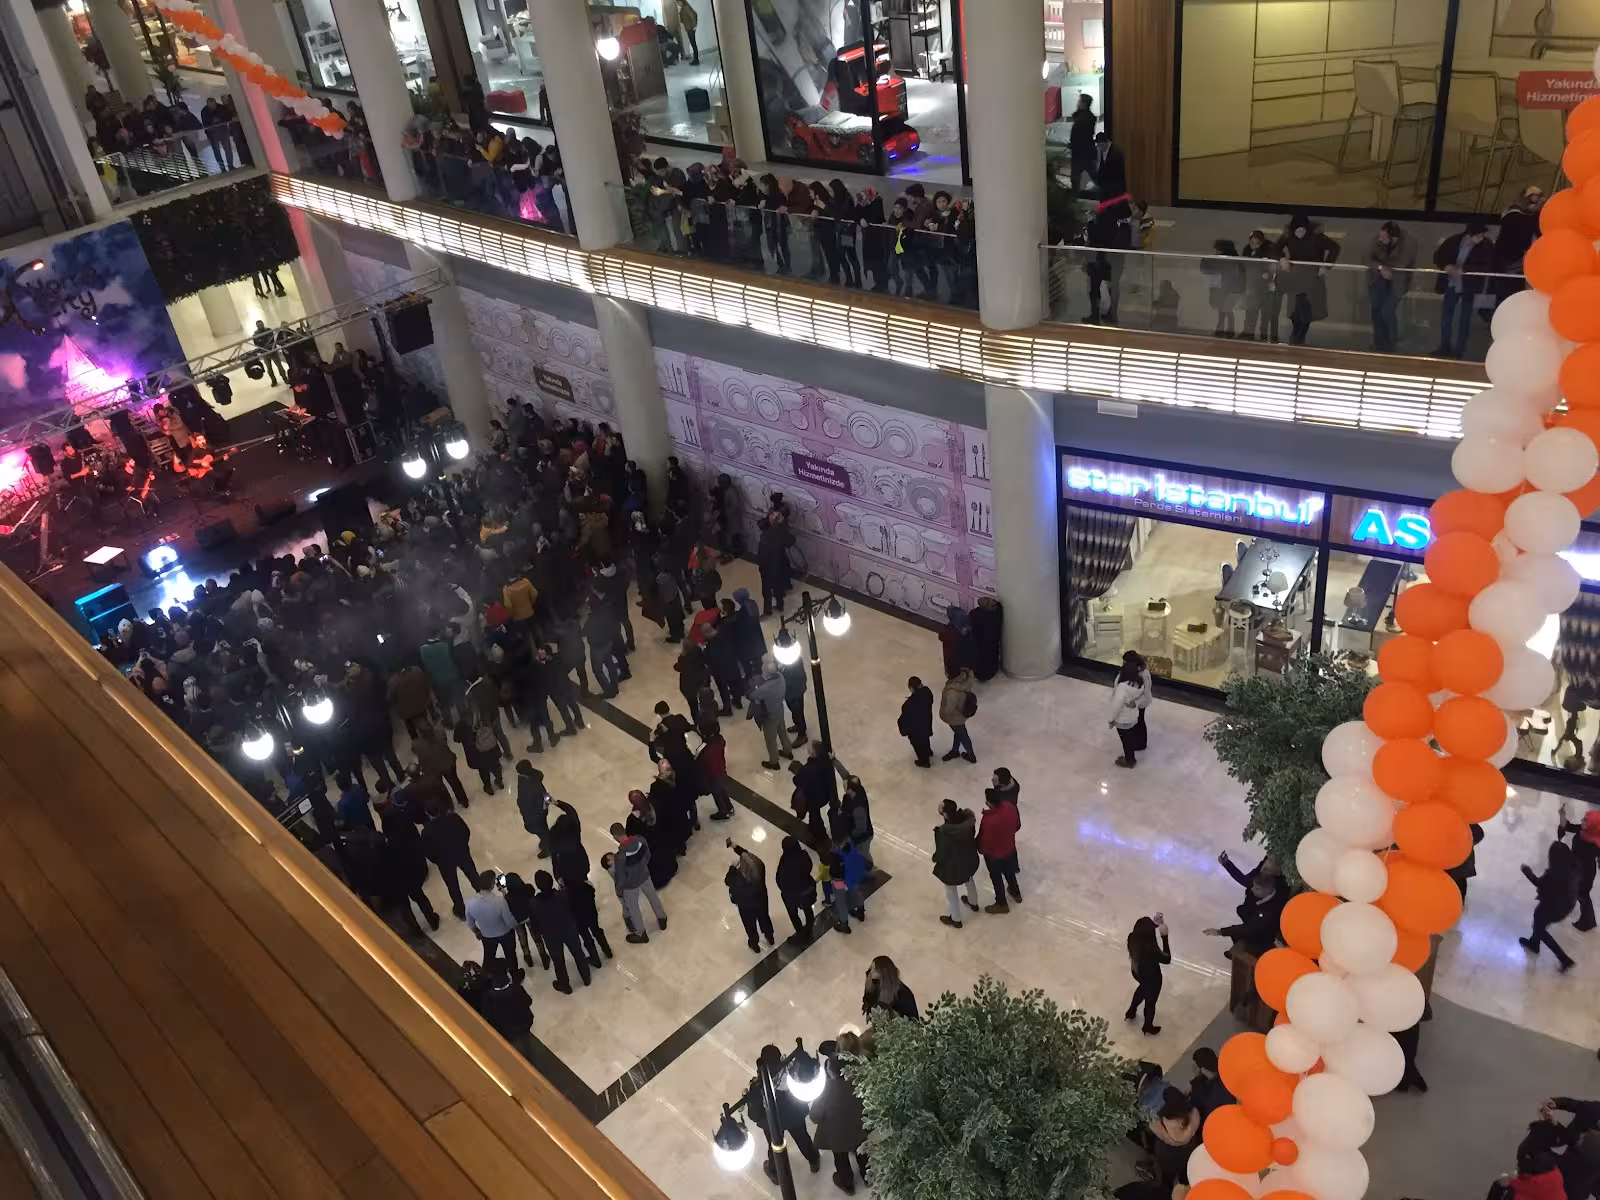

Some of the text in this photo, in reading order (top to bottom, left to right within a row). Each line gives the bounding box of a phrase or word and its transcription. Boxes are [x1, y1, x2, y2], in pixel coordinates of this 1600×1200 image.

[798, 468, 845, 489] Hizmetinizde
[805, 461, 835, 476] Yakında
[1134, 498, 1243, 523] Perde Sistemleri
[1351, 508, 1431, 550] AS
